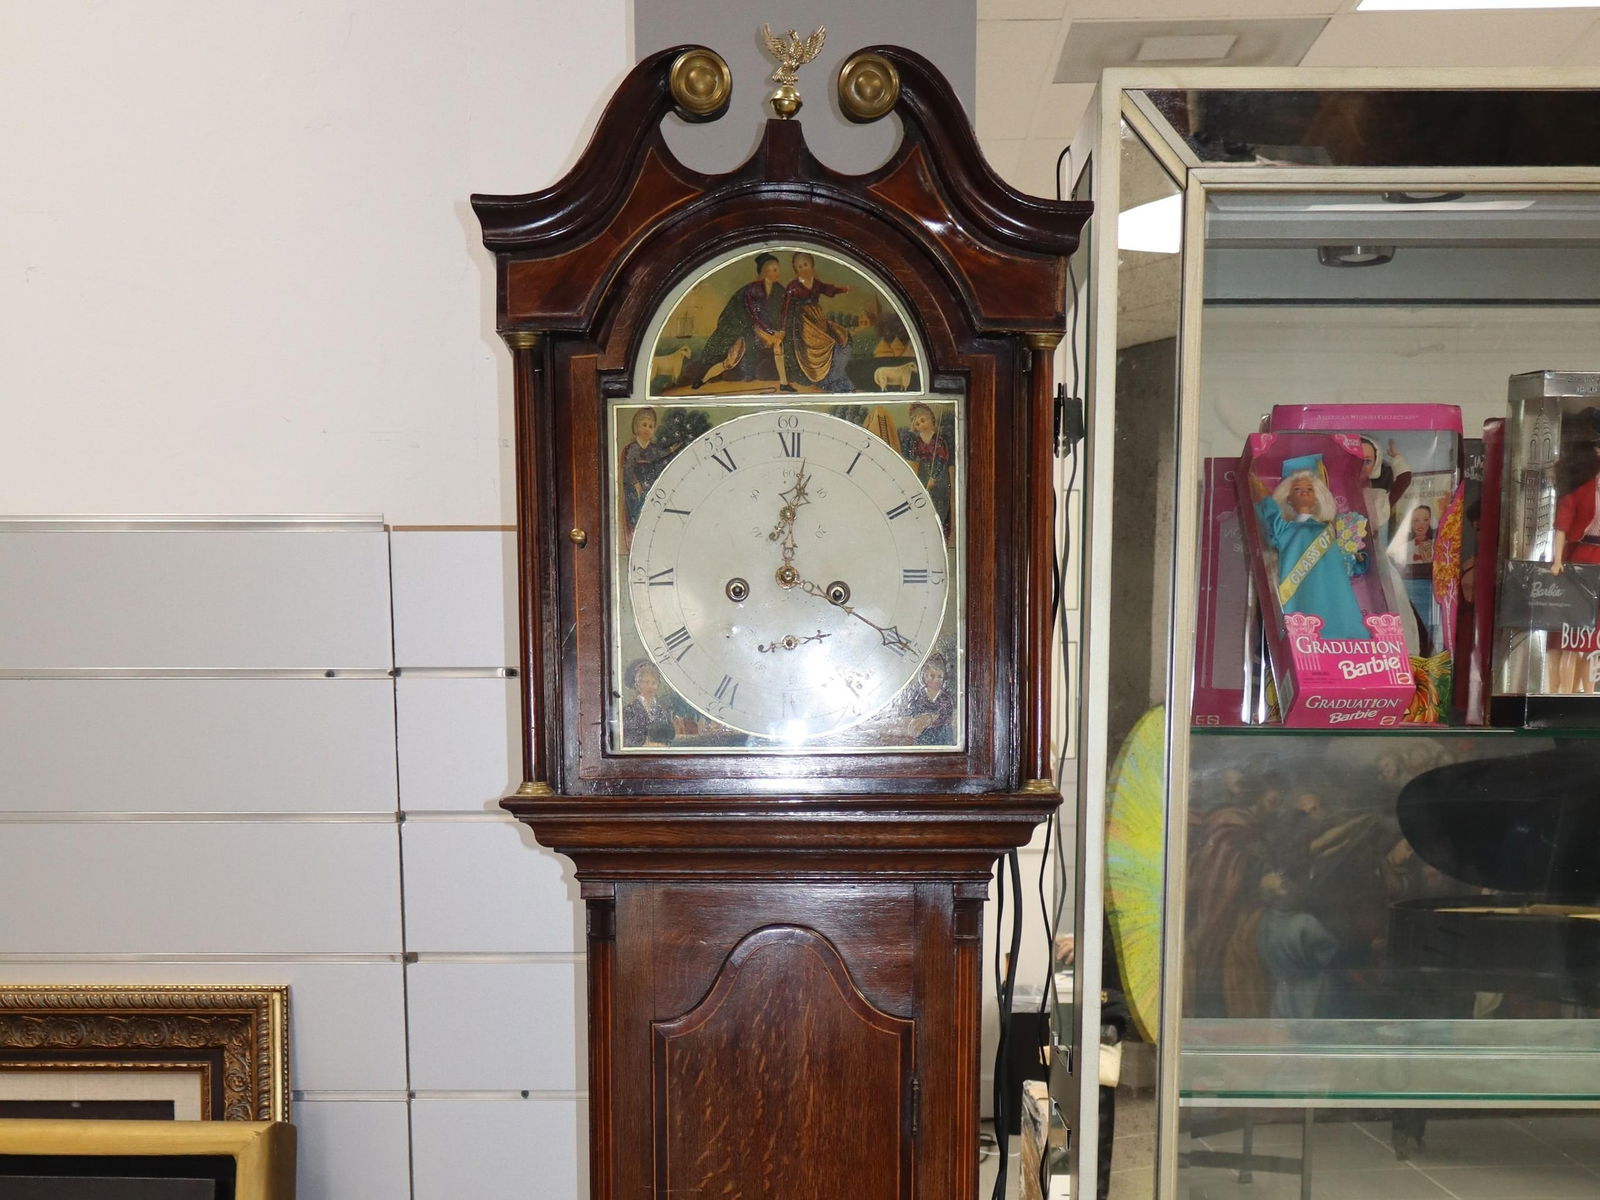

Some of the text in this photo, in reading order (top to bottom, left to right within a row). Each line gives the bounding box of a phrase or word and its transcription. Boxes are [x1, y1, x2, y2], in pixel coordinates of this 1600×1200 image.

[777, 414, 799, 430] 60
[777, 431, 801, 458] XII
[859, 437, 872, 450] 5
[910, 490, 927, 510] 10
[886, 500, 912, 521] II
[902, 568, 928, 585] III
[1289, 548, 1321, 585] CLASS
[1530, 581, 1564, 598] Barbie
[1296, 635, 1401, 655] GRADUATION
[1560, 622, 1597, 649] BUSY
[1338, 655, 1401, 680] Barbie
[1305, 695, 1400, 709] GRADUATION
[1329, 709, 1378, 724] Barbie
